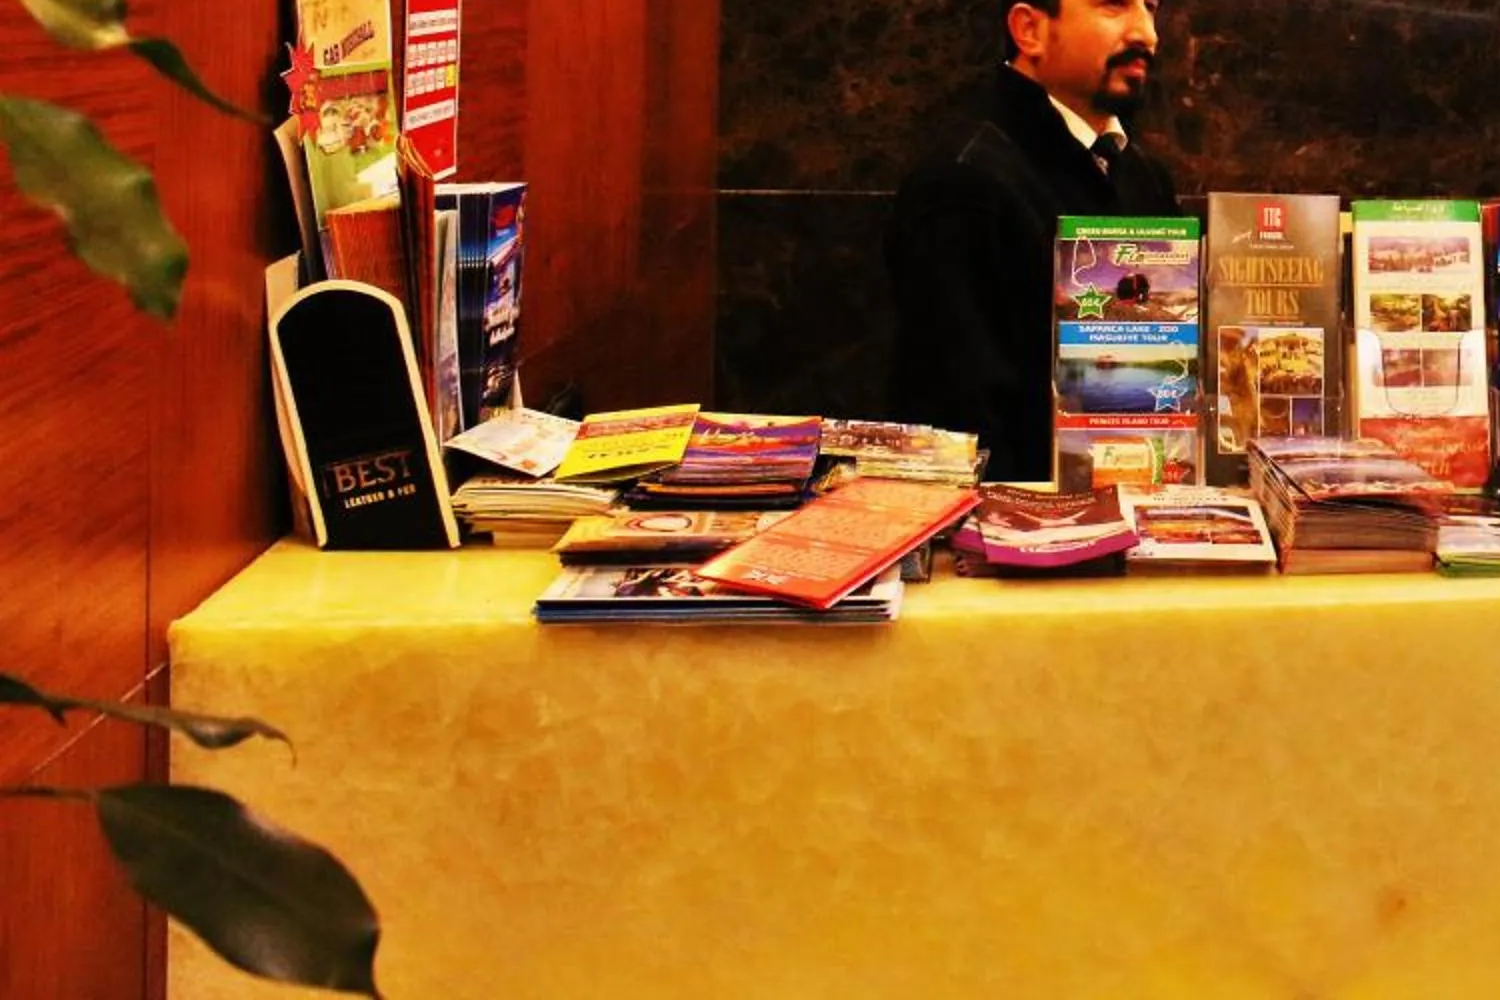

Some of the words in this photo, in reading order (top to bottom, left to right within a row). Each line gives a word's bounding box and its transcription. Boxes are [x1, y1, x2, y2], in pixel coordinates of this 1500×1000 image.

[1219, 255, 1324, 282] SIGHTSEEING
[1244, 287, 1300, 315] TOURS
[332, 450, 412, 493] BEST
